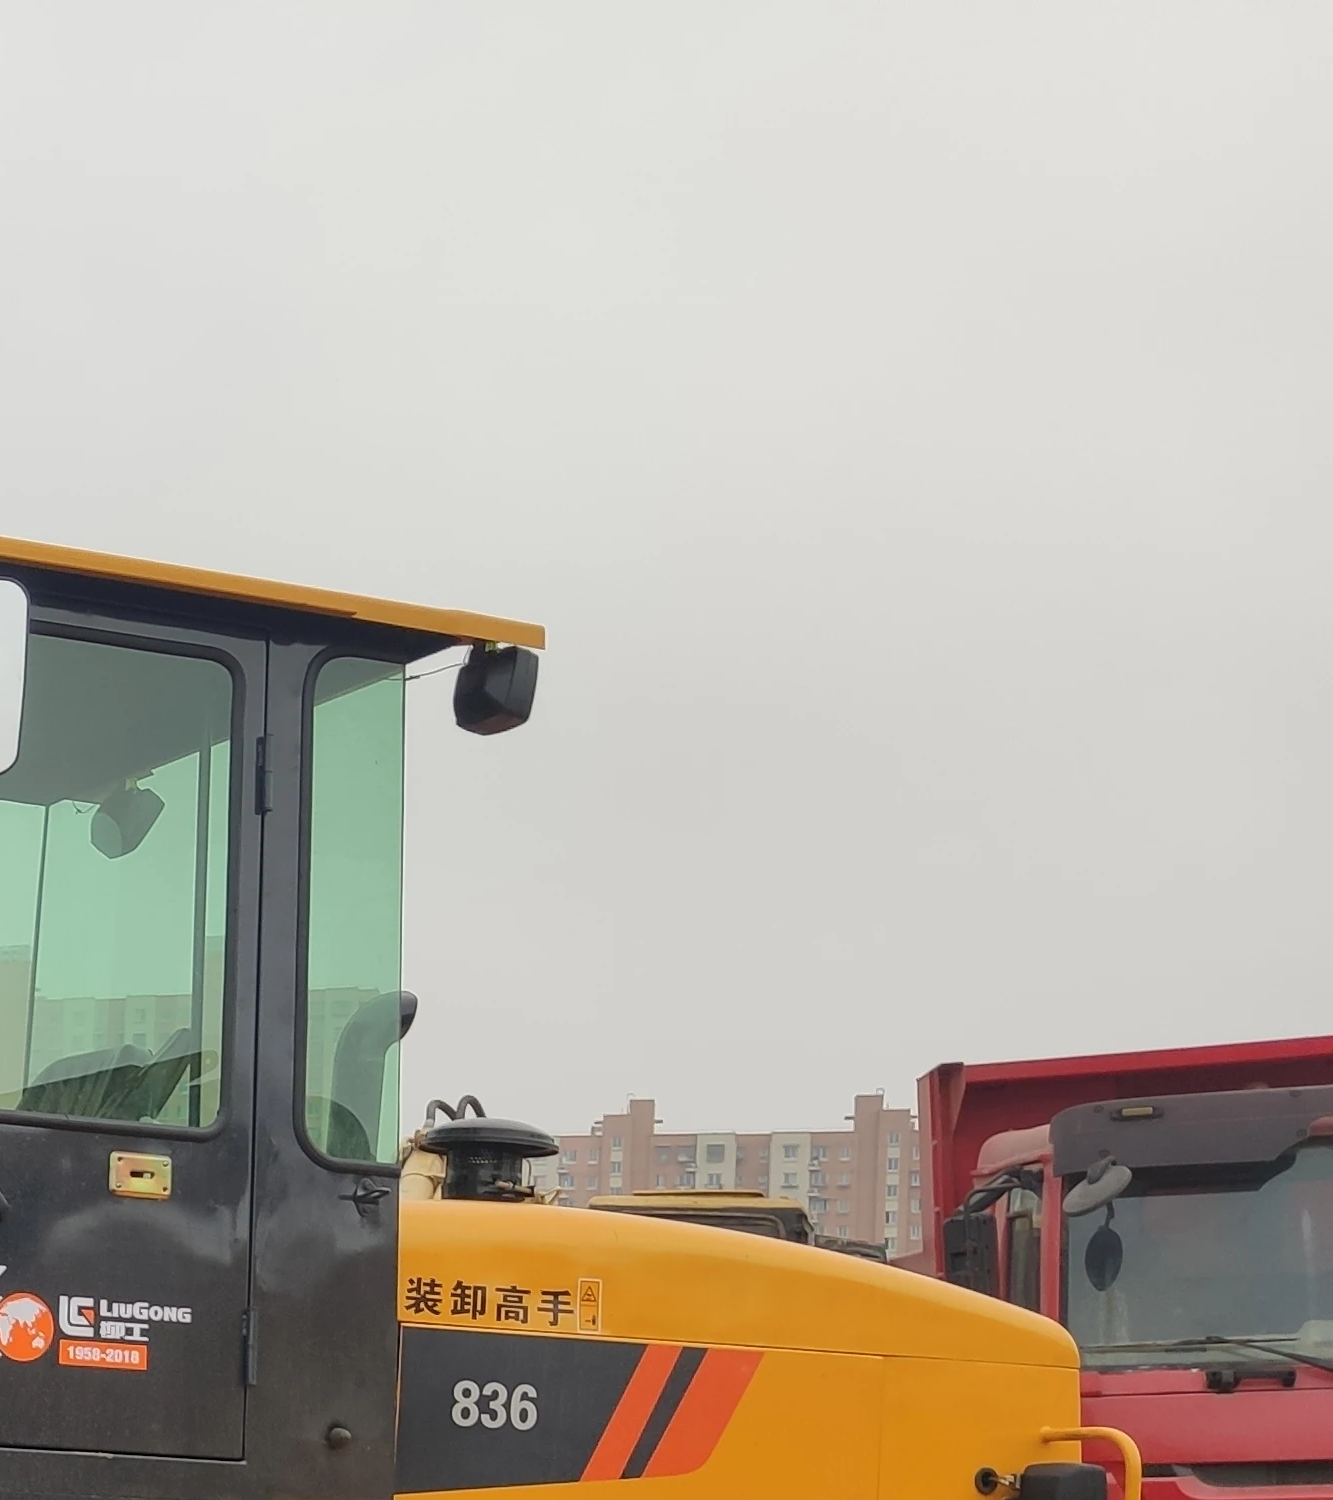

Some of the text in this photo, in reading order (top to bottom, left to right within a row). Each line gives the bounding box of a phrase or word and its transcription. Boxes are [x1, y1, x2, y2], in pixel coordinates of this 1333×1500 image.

[404, 1276, 575, 1327] 装卸高手
[66, 1345, 140, 1365] 1958-2018
[451, 1379, 539, 1432] 836
